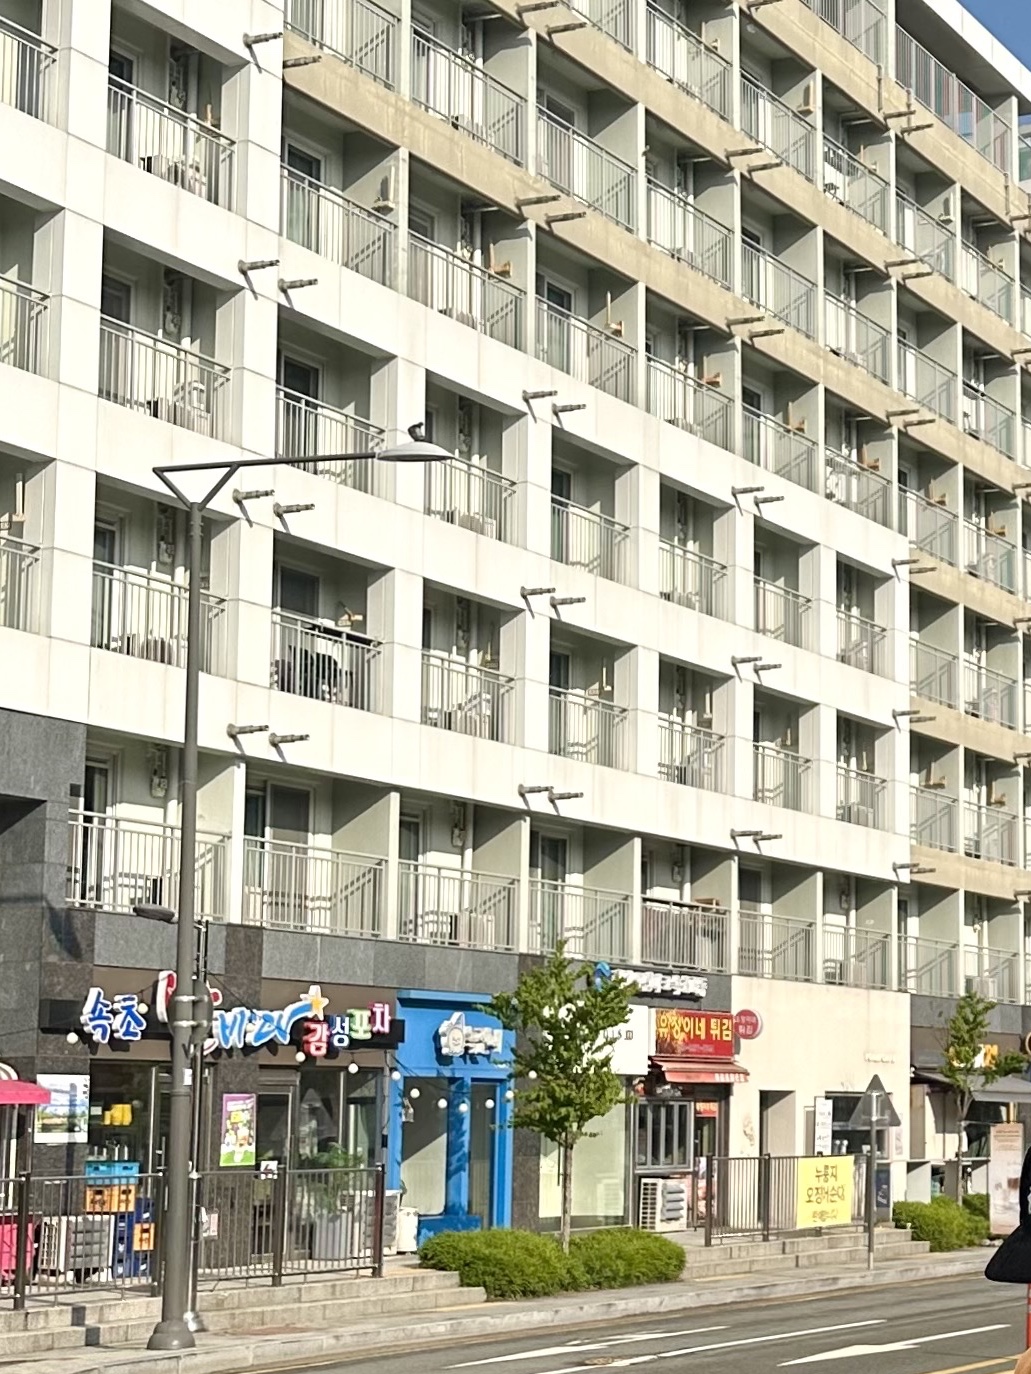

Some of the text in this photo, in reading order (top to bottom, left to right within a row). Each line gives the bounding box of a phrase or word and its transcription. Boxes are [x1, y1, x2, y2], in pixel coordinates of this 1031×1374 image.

[80, 987, 147, 1044] 속초
[304, 1002, 391, 1057] 감성포차
[815, 1164, 838, 1183] 누룽지
